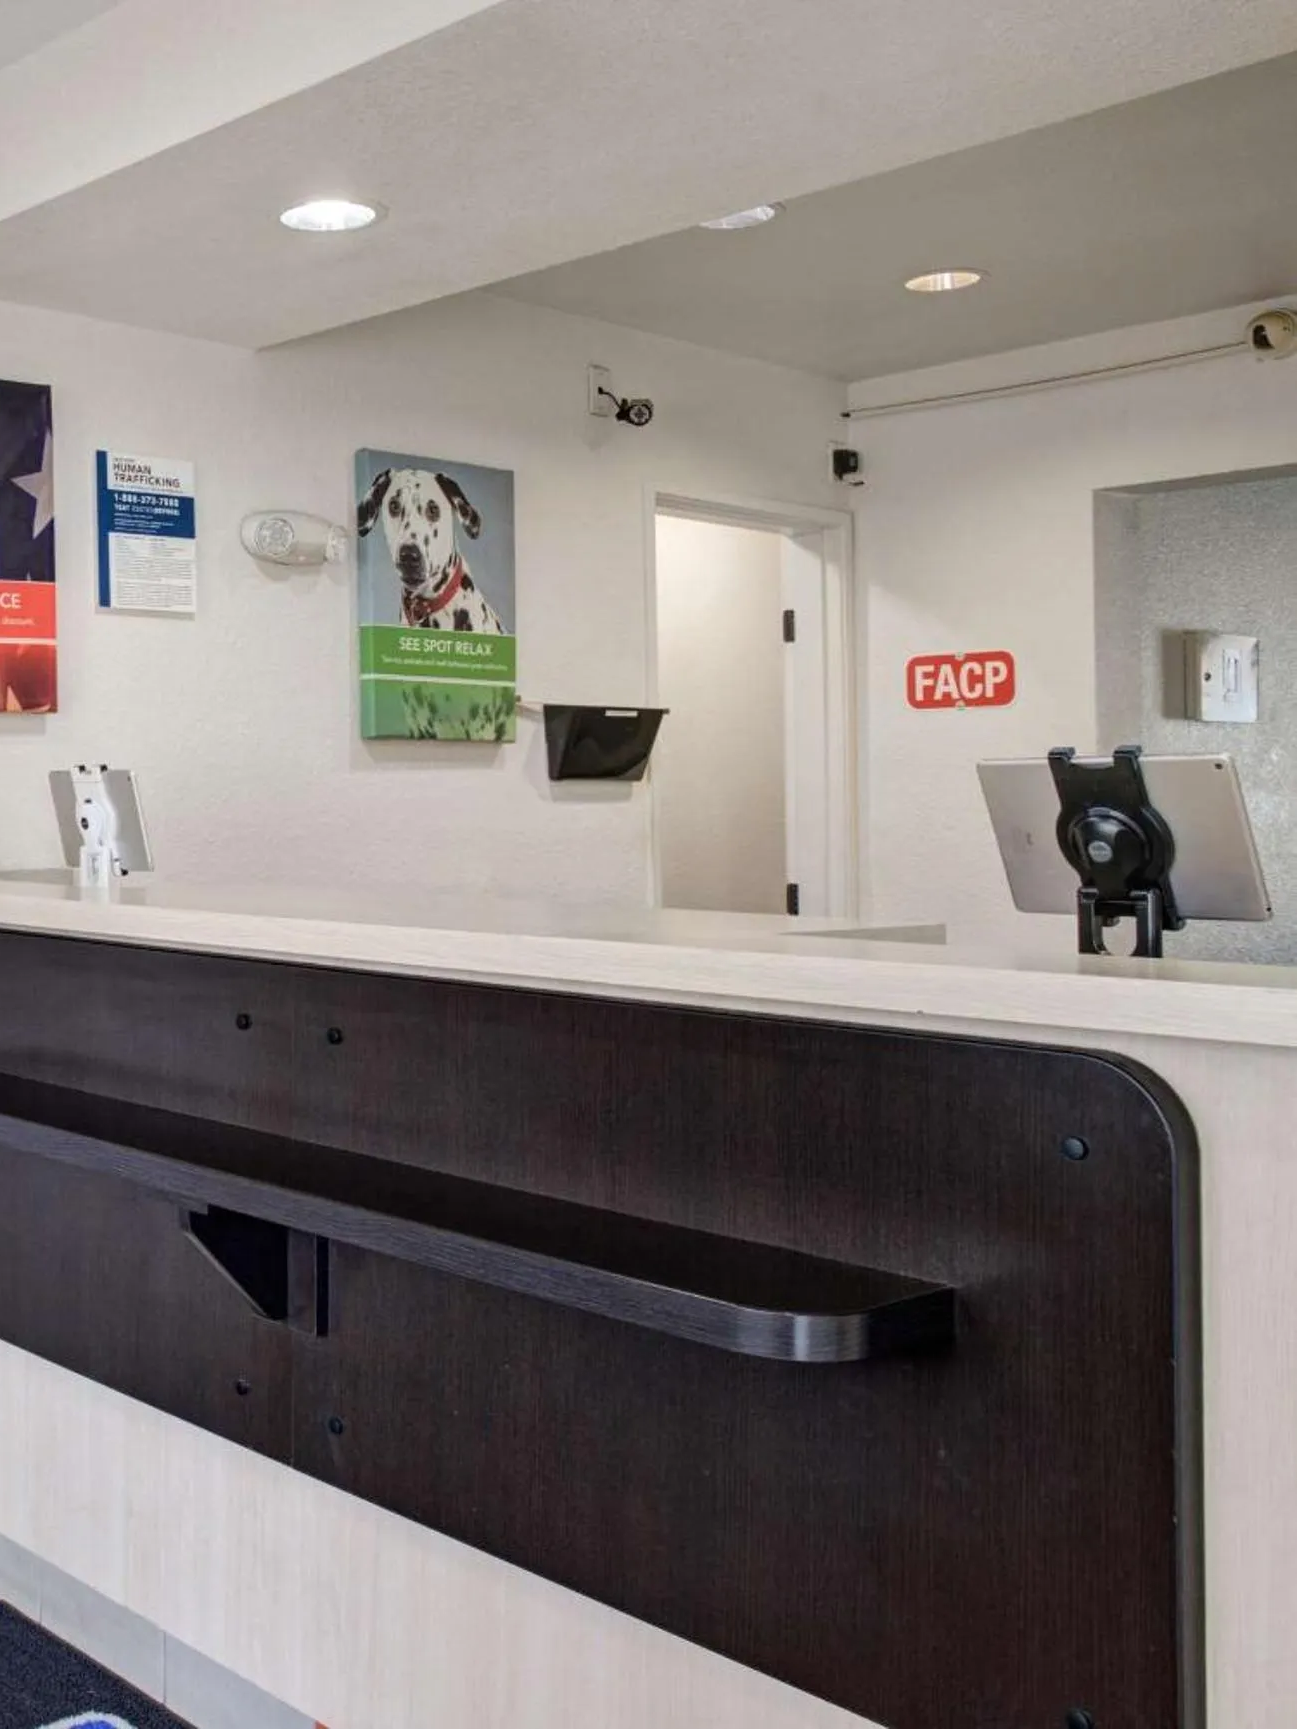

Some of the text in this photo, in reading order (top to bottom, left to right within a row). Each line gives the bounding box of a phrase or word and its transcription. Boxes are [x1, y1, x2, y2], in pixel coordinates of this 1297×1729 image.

[113, 462, 152, 475] HUMAN
[114, 473, 181, 488] TRAFFICKING
[399, 636, 493, 656] SEE SPOT RELAX
[914, 660, 1008, 701] FACP
